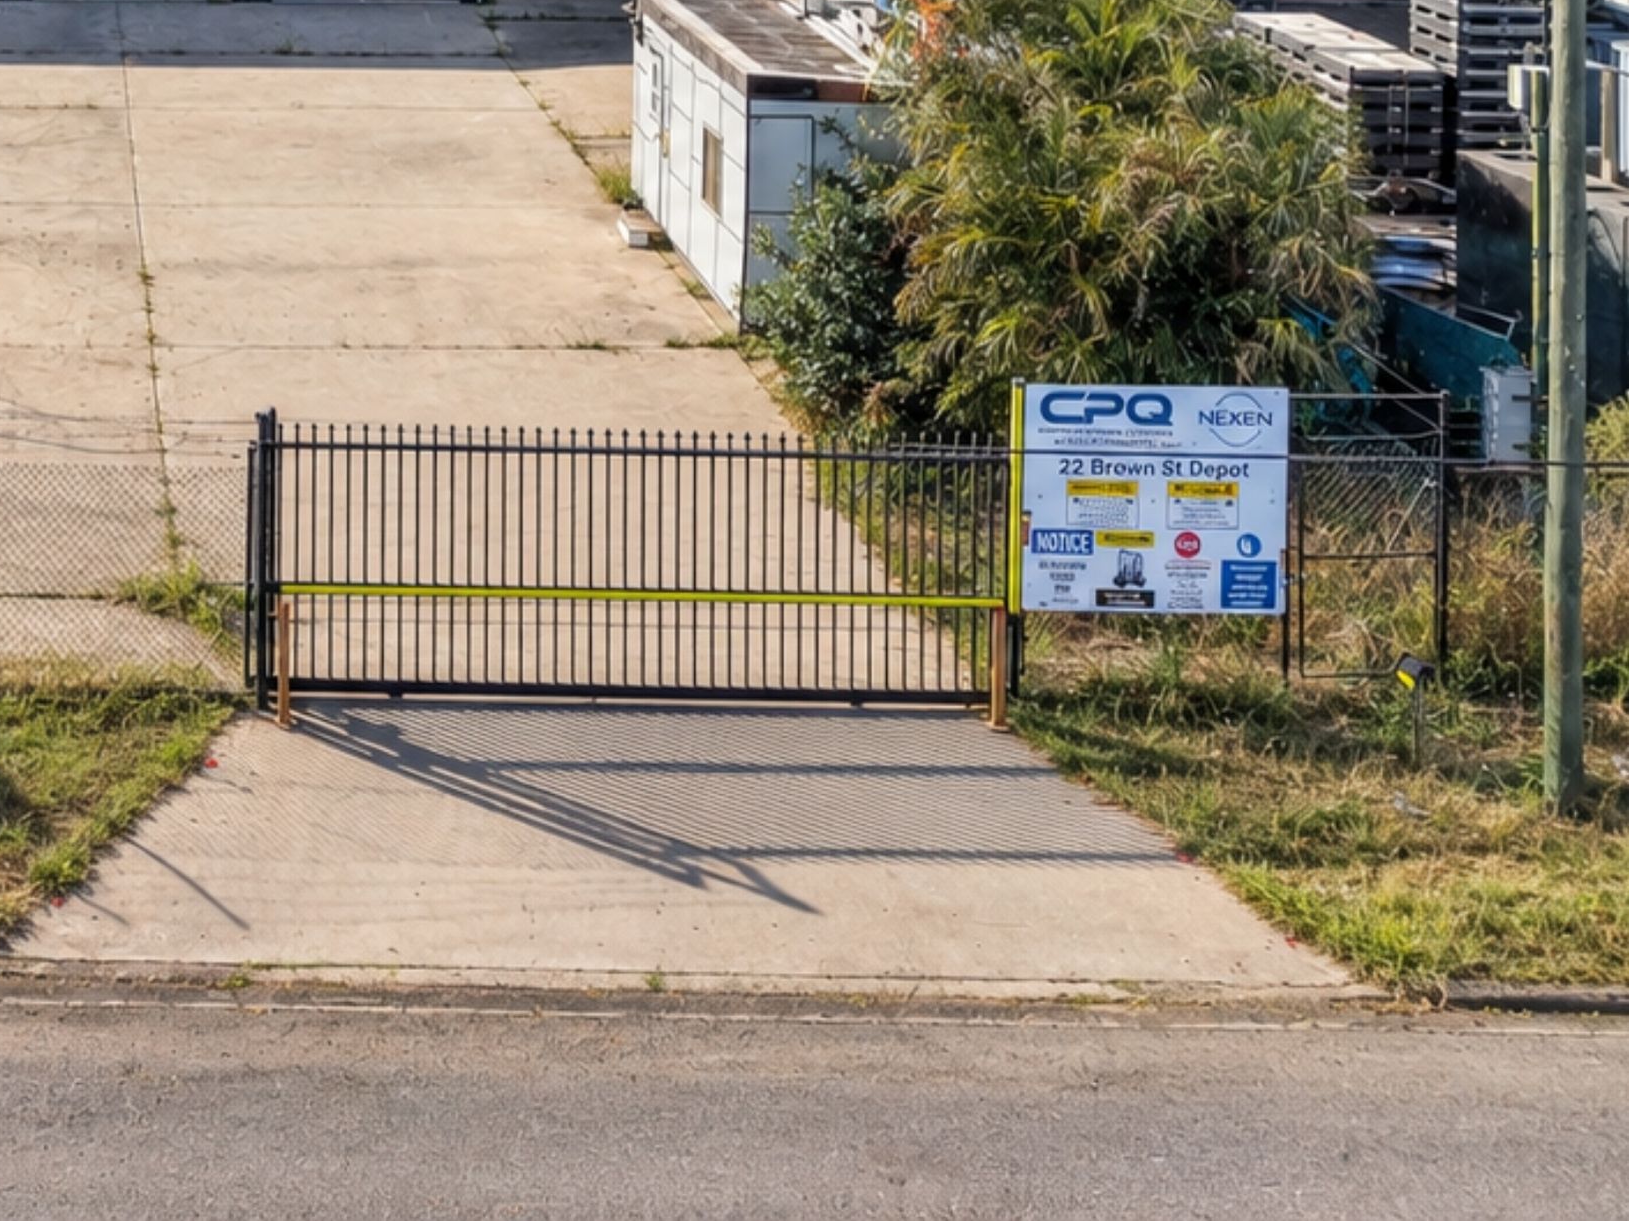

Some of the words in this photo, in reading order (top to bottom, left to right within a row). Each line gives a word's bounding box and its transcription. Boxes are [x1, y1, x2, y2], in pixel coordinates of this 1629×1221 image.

[1040, 391, 1173, 426] CPQ
[1198, 409, 1273, 427] NEXEN
[1058, 458, 1084, 476] 22
[1090, 458, 1155, 477] Brown
[1161, 460, 1183, 477] St
[1189, 460, 1250, 481] Depot
[1036, 532, 1091, 554] NOTICE
